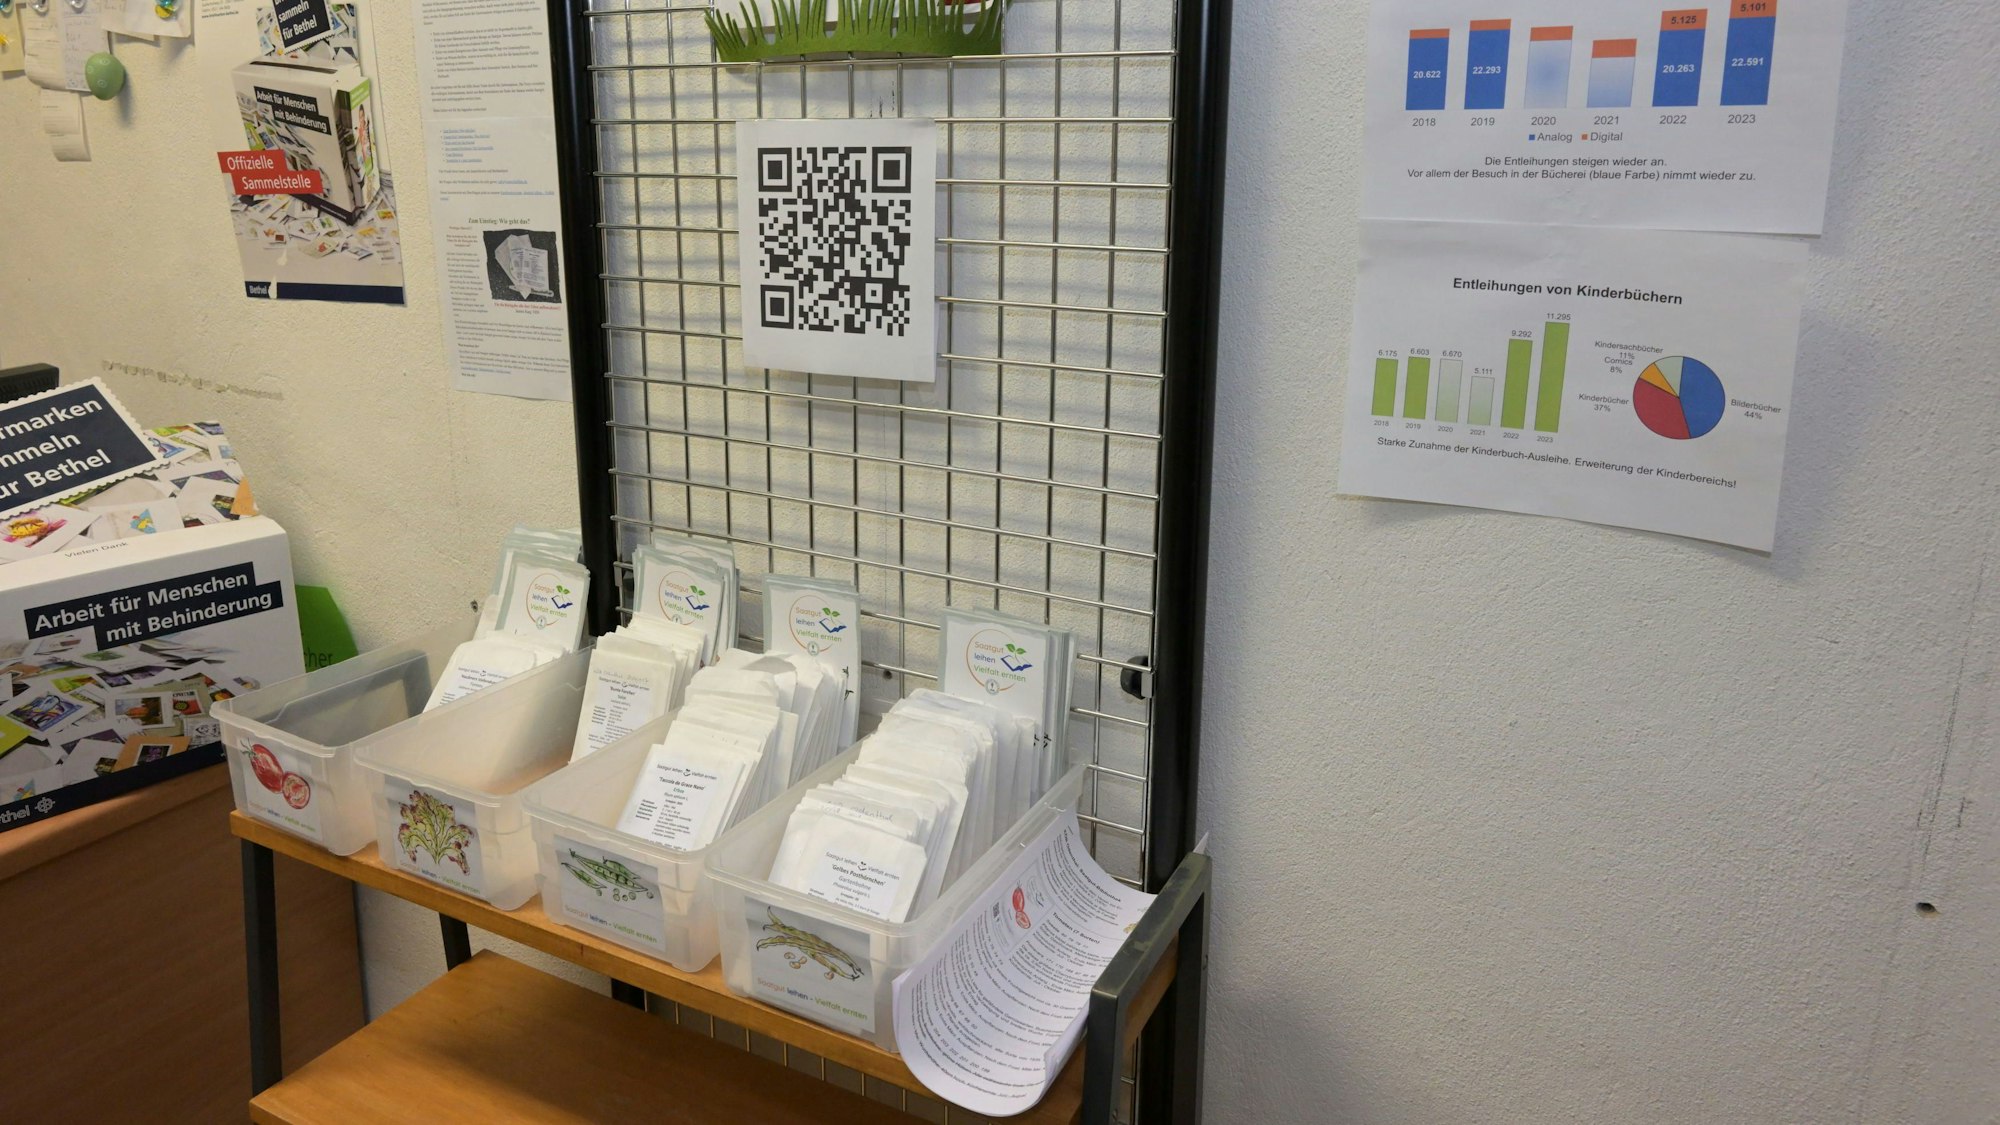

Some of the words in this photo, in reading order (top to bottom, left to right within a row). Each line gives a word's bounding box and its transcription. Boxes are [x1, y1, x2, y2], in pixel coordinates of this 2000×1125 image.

[1740, 3, 1767, 12] 5.101
[1671, 16, 1697, 24] 5.125
[282, 26, 293, 40] für
[294, 14, 317, 35] Bethel
[1731, 58, 1764, 67] 22.591
[1472, 66, 1501, 75] 22.293
[1662, 64, 1695, 73] 20.263
[1413, 70, 1441, 79] 20.622
[257, 90, 272, 101] Arbeit
[274, 93, 282, 103] für
[284, 95, 316, 112] Menschen
[274, 110, 284, 120] mit
[286, 111, 327, 132] Behinderung
[1412, 118, 1436, 127] 2018
[1470, 117, 1495, 126] 2019
[1531, 116, 1557, 126] 2020
[1593, 116, 1620, 125] 2021
[1659, 115, 1687, 124] 2022
[1728, 114, 1756, 124] 2023
[1537, 132, 1573, 143] Analog
[1590, 132, 1623, 143] Digital
[227, 155, 274, 170] Offizielle
[1485, 157, 1501, 166] Die
[1505, 157, 1569, 167] Entleihungen
[1572, 157, 1609, 168] steigen
[1612, 157, 1648, 166] wieder
[1650, 158, 1667, 166] an.
[1407, 169, 1423, 178] Vor
[1426, 169, 1450, 178] allem
[1454, 169, 1469, 178] der
[1472, 169, 1508, 178] Besuch
[1511, 170, 1519, 178] in
[1522, 170, 1538, 178] der
[1541, 169, 1586, 179] Bücherei
[1589, 170, 1622, 181] (blaue
[1624, 170, 1660, 181] Farbe)
[1663, 171, 1697, 180] nimmt
[1699, 171, 1736, 181] wieder
[1739, 173, 1756, 181] zu.
[242, 174, 311, 190] Sammelstelle
[1453, 278, 1542, 295] Entleihungen
[1547, 285, 1572, 296] von
[1577, 285, 1683, 305] Kinderbüchern
[1546, 313, 1571, 321] 11.295
[1511, 330, 1533, 338] 9.292
[1410, 348, 1430, 356] 6.603
[1594, 340, 1664, 354] Kindersachbücher
[1378, 349, 1398, 358] 6.175
[1442, 350, 1463, 358] 6.670
[1619, 352, 1636, 360] 11%
[1604, 356, 1633, 366] Comics
[1474, 367, 1493, 376] 5.111
[1610, 366, 1623, 374] 8%
[1578, 393, 1630, 405] Kinderbücher
[1593, 404, 1612, 413] 37%
[1731, 398, 1782, 414] Bilderbücher
[1744, 410, 1763, 421] 44%
[1373, 419, 1390, 428] 2018
[1405, 422, 1421, 430] 2019
[1437, 425, 1454, 433] 2020
[1469, 428, 1486, 437] 2021
[1503, 431, 1519, 440] 2022
[1536, 435, 1554, 444] 2023
[24, 449, 111, 488] Bethel
[1377, 437, 1407, 448] Starke
[1408, 439, 1451, 452] Zunahme
[1454, 444, 1470, 454] der
[1471, 446, 1572, 466] Kinderbuch-Ausleihe.
[1575, 457, 1634, 475] Erweiterung
[1636, 465, 1654, 476] der
[1656, 468, 1737, 489] Kinderbereichs!
[65, 547, 99, 559] Vielen
[101, 541, 129, 552] Dank
[665, 580, 689, 593] Saatgut
[532, 593, 548, 602] leihen
[664, 589, 682, 601] leihen
[34, 603, 103, 632] Arbeit
[110, 595, 141, 615] für
[148, 573, 248, 607] Menschen
[530, 603, 549, 614] Vielfalt
[549, 608, 568, 618] ernten
[664, 600, 684, 612] Vielfalt
[684, 610, 704, 620] ernten
[795, 607, 821, 618] Saatgut
[106, 621, 142, 642] mit
[148, 591, 272, 633] Behinderung
[795, 618, 815, 627] leihen
[796, 629, 819, 639] Vielfalt
[820, 634, 842, 643] ernten
[974, 641, 1004, 654] Saatgut
[304, 648, 333, 668] her
[974, 652, 996, 664] leihen
[973, 664, 999, 676] Vielfalt
[1001, 673, 1026, 682] ernten
[826, 851, 844, 862] Saatgut
[845, 857, 858, 866] leihen
[868, 866, 884, 876] Vielfalt
[884, 871, 900, 881] ernten
[590, 914, 608, 926] leihen
[613, 923, 635, 935] Vielfalt
[636, 932, 658, 943] ernten
[757, 977, 785, 993] Saatgut
[787, 987, 809, 1000] leihen
[815, 997, 841, 1011] Vielfalt
[842, 1007, 868, 1020] ernten
